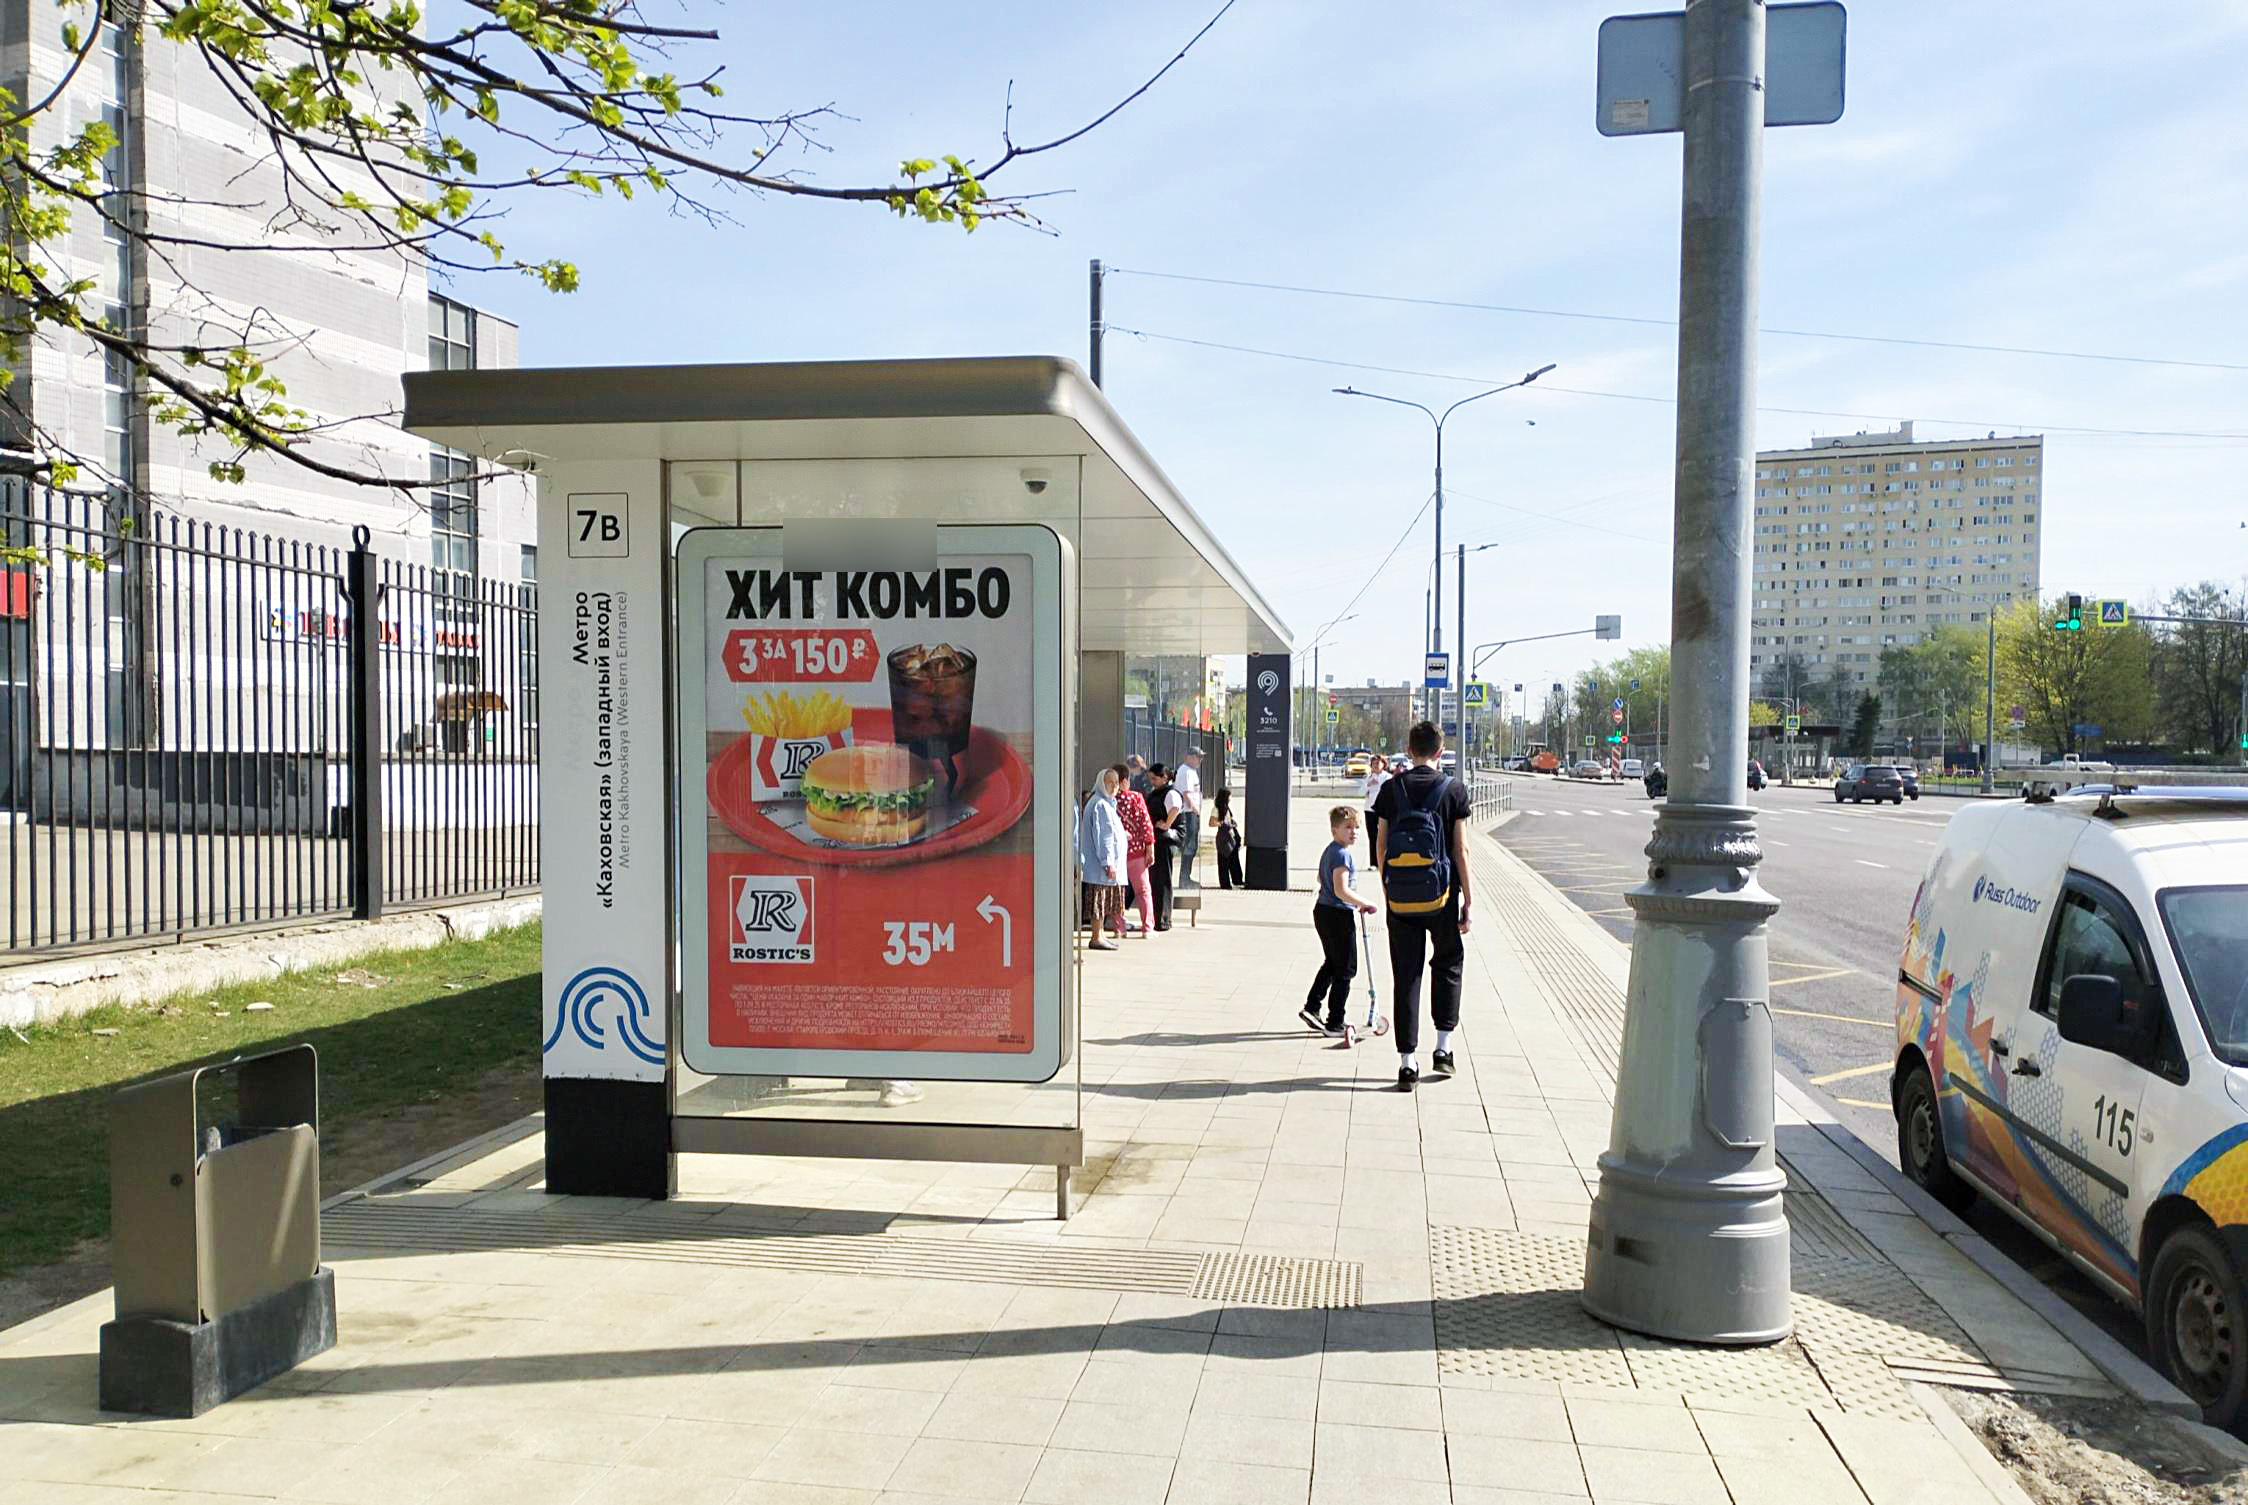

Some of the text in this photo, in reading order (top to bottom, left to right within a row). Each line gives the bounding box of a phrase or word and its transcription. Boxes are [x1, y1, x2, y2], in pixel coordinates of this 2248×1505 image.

[725, 566, 1011, 620] ХИТ КОМБО
[572, 591, 592, 665] Метро
[738, 638, 758, 675] 3
[762, 638, 787, 660] ЗА
[615, 591, 631, 869] Metro Kakhovskaya (Western Entrance)
[1260, 716, 1278, 725] 3210
[591, 592, 614, 909] «Каховская» (западный вход)
[745, 890, 797, 932] R
[1984, 882, 2041, 913] Russ Outdoor
[732, 947, 812, 961] ROSTIC'S
[2094, 1093, 2136, 1158] 115
